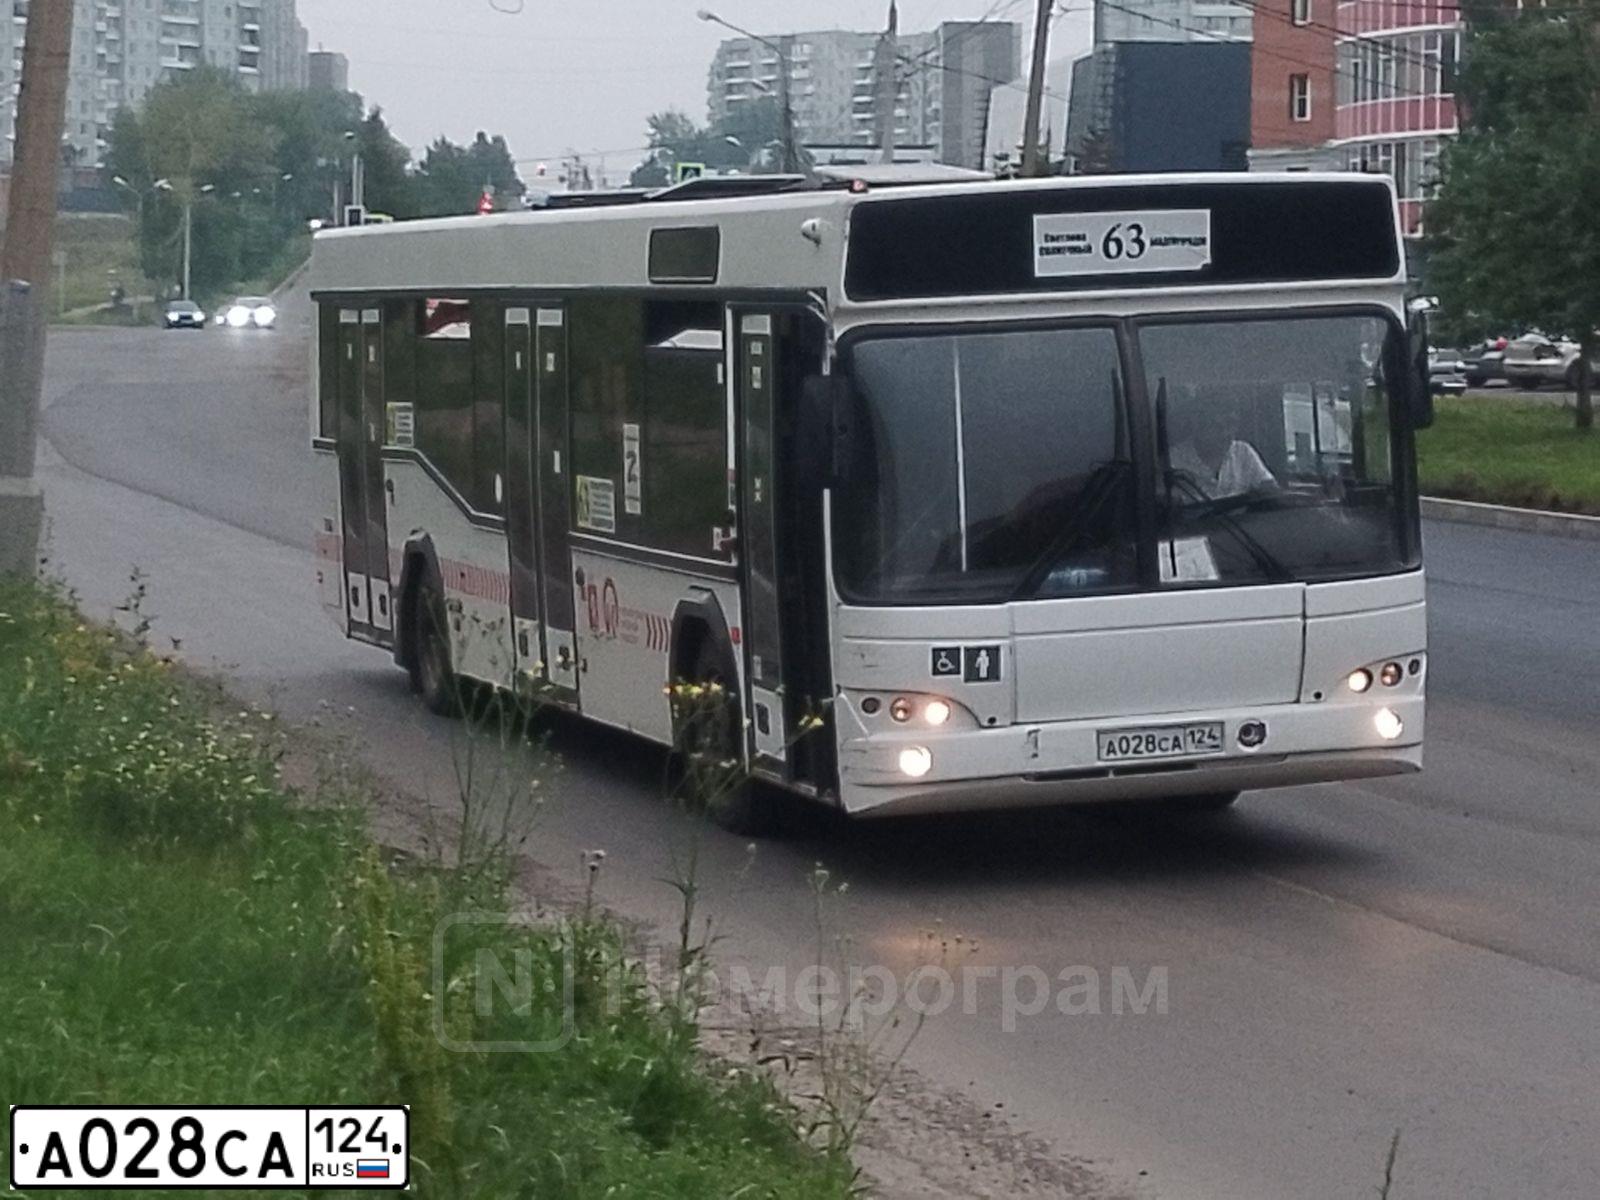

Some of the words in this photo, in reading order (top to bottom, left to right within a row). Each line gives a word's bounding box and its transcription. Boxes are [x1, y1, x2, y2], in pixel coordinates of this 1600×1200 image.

[1102, 223, 1146, 260] 63
[1106, 734, 1183, 756] А028СА
[1187, 729, 1218, 745] 124
